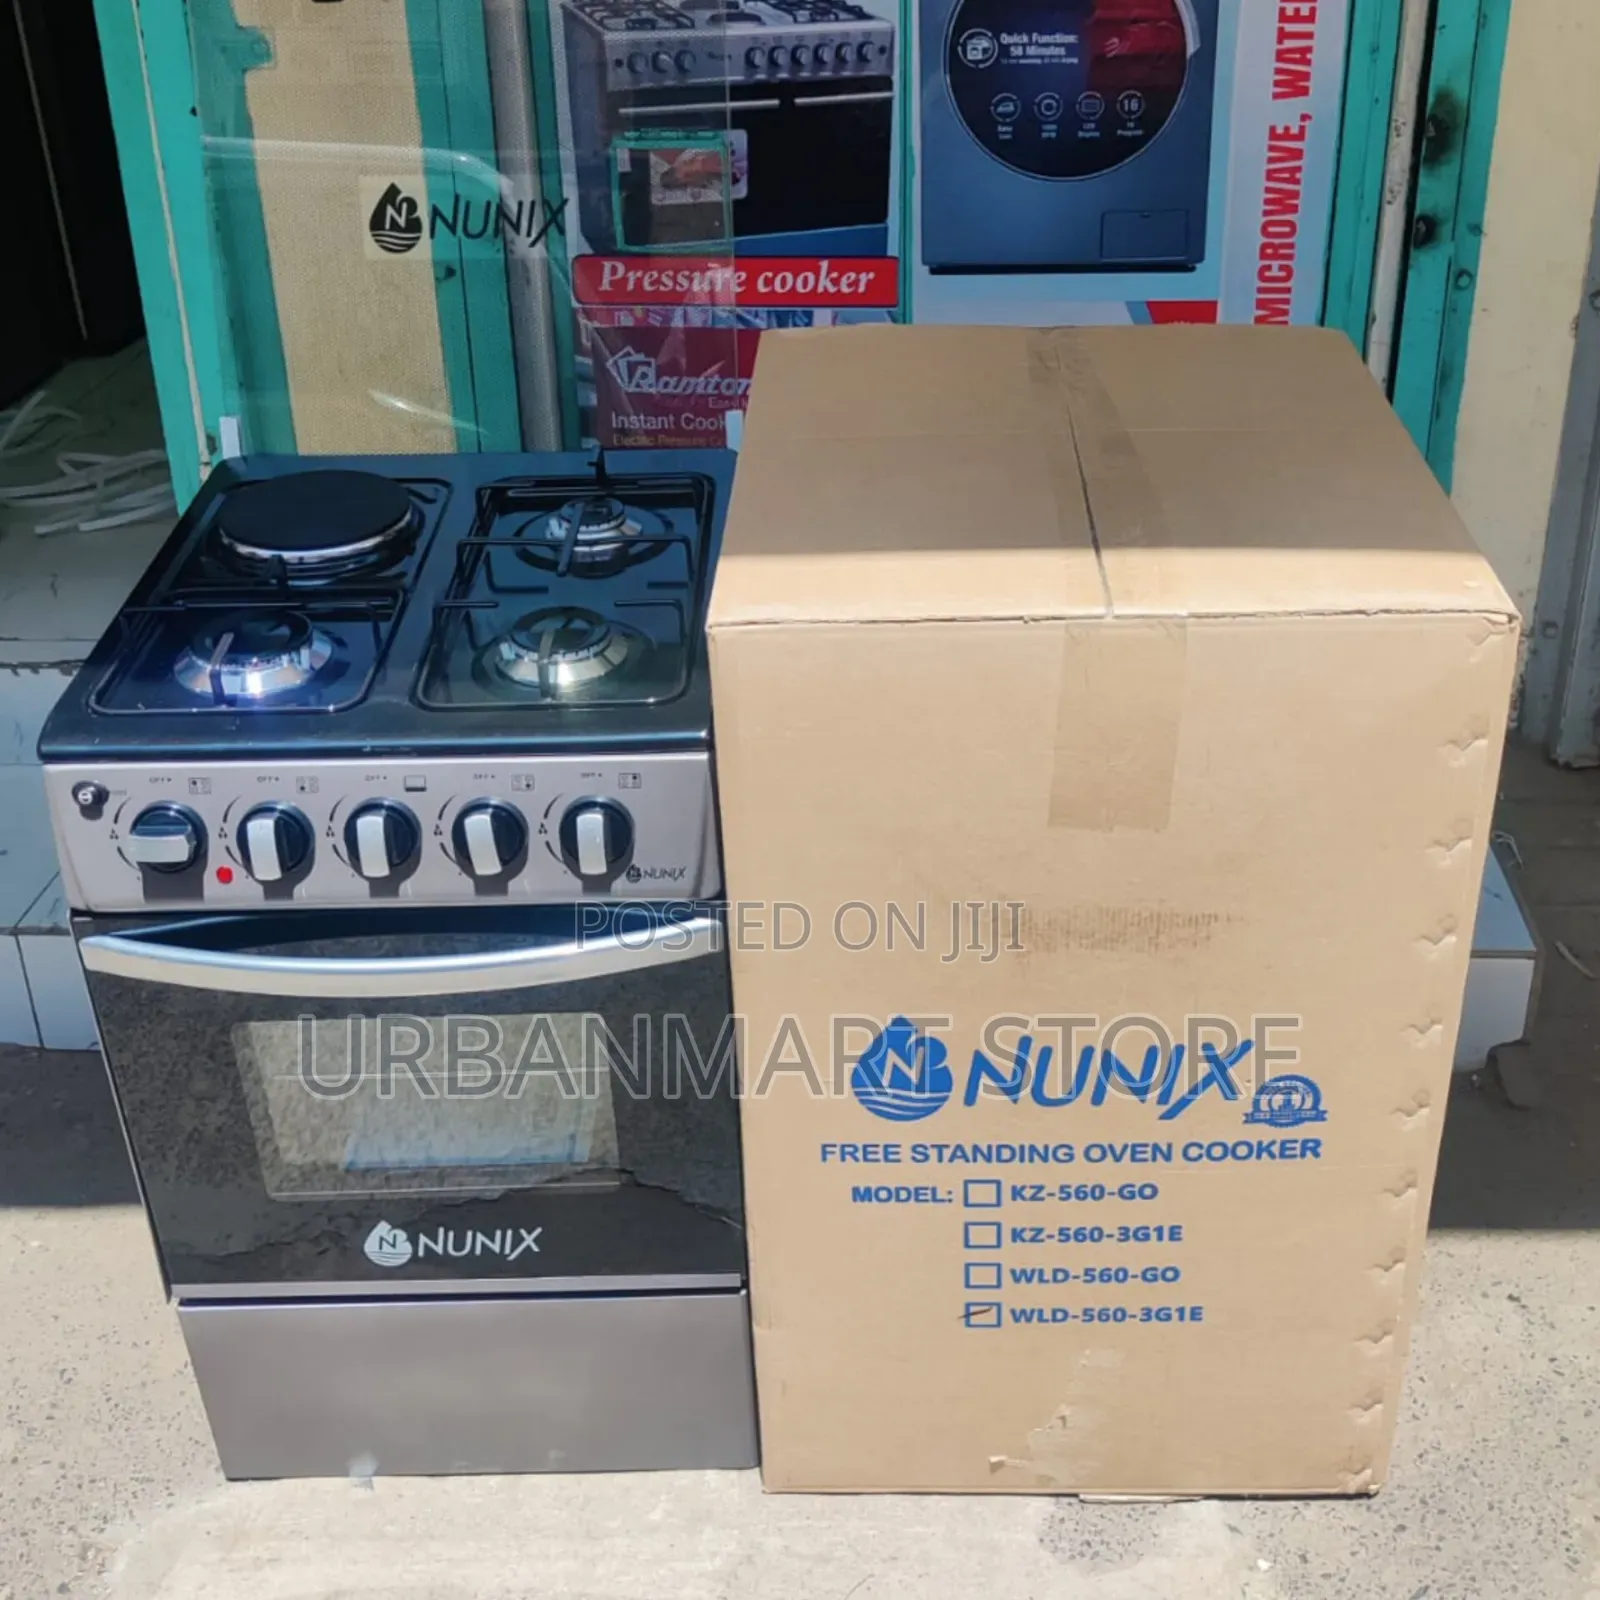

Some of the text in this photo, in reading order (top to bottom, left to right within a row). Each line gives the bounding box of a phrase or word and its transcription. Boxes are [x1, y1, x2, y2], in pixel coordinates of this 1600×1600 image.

[1255, 0, 1317, 325] MICROWAVE, WATE
[429, 192, 570, 248] NUNIX
[599, 260, 875, 294] Pressure cooker
[611, 411, 675, 430] Instant
[643, 866, 687, 882] NUNIX
[963, 1034, 1254, 1121] NUNIX
[821, 1136, 1323, 1165] FREE STANDING OVEN COOKER
[850, 1182, 1160, 1205] MODEL: KZ-560-GO
[417, 1226, 543, 1261] NUNIX
[1010, 1223, 1184, 1245] KZ-560-3G1E
[1010, 1265, 1182, 1286] WLD-560-GO
[1010, 1305, 1205, 1325] WLD-560-3G1E
